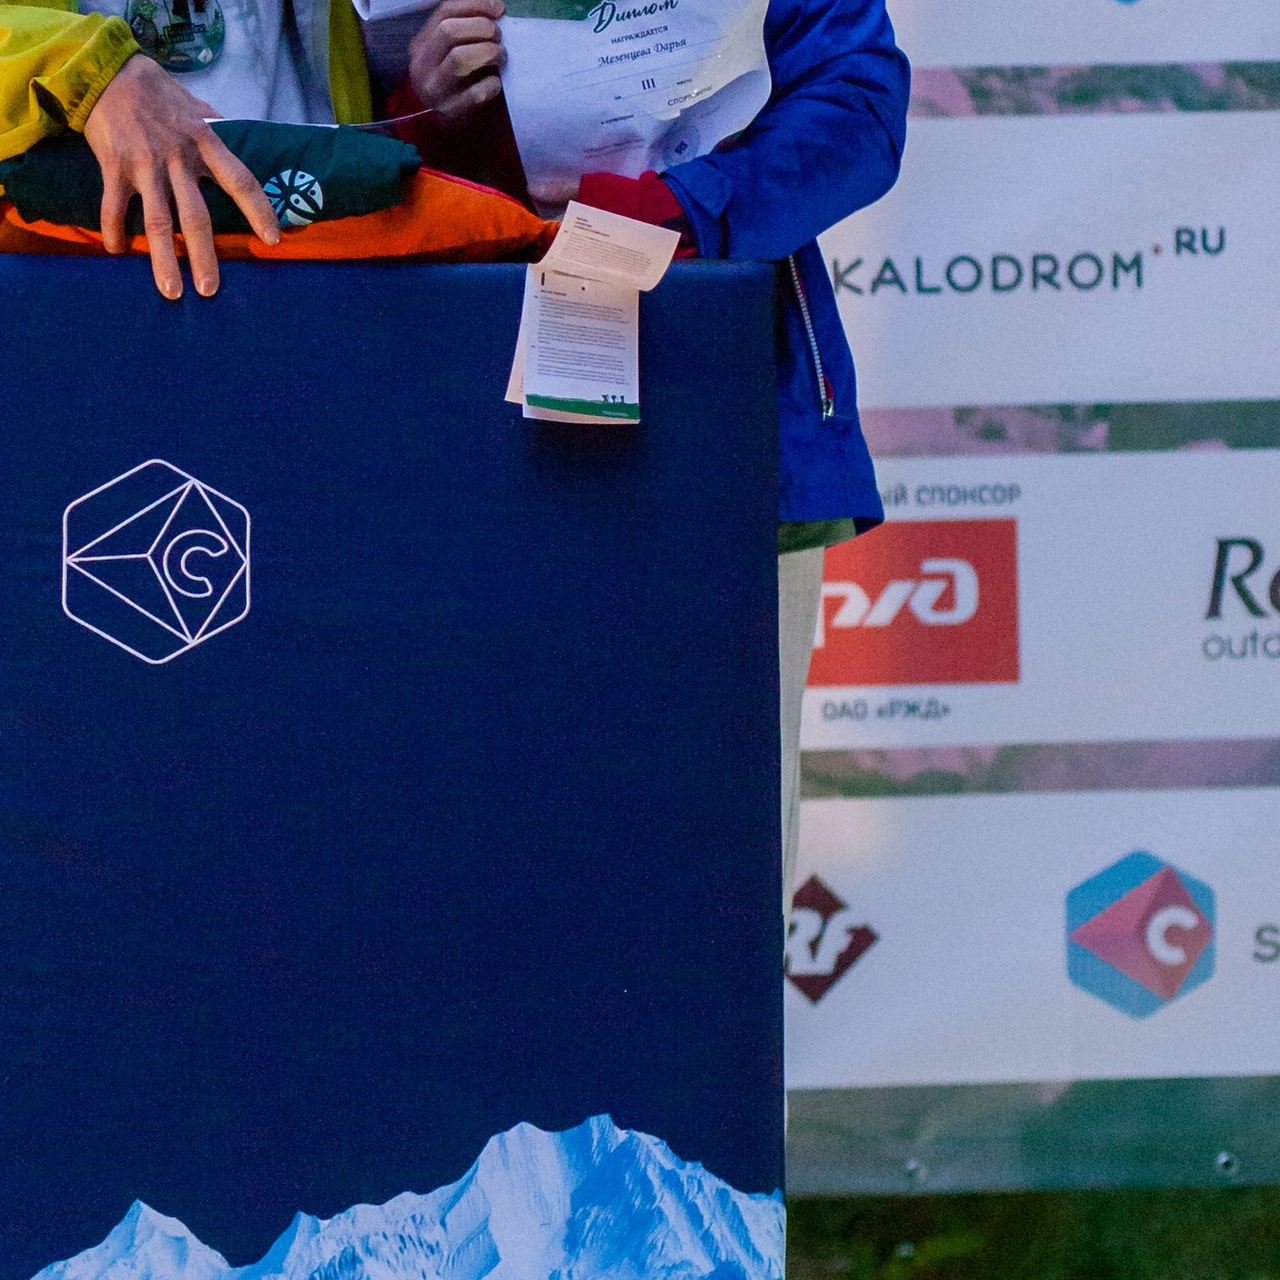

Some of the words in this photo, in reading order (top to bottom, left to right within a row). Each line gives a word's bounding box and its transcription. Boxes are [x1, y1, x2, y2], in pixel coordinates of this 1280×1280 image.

[610, 24, 669, 45] НАГРАЖДАЕТСЯ
[598, 46, 652, 67] Мезенцева
[653, 38, 687, 54] Дарья
[641, 78, 656, 90] III
[832, 250, 1145, 296] KALODROM
